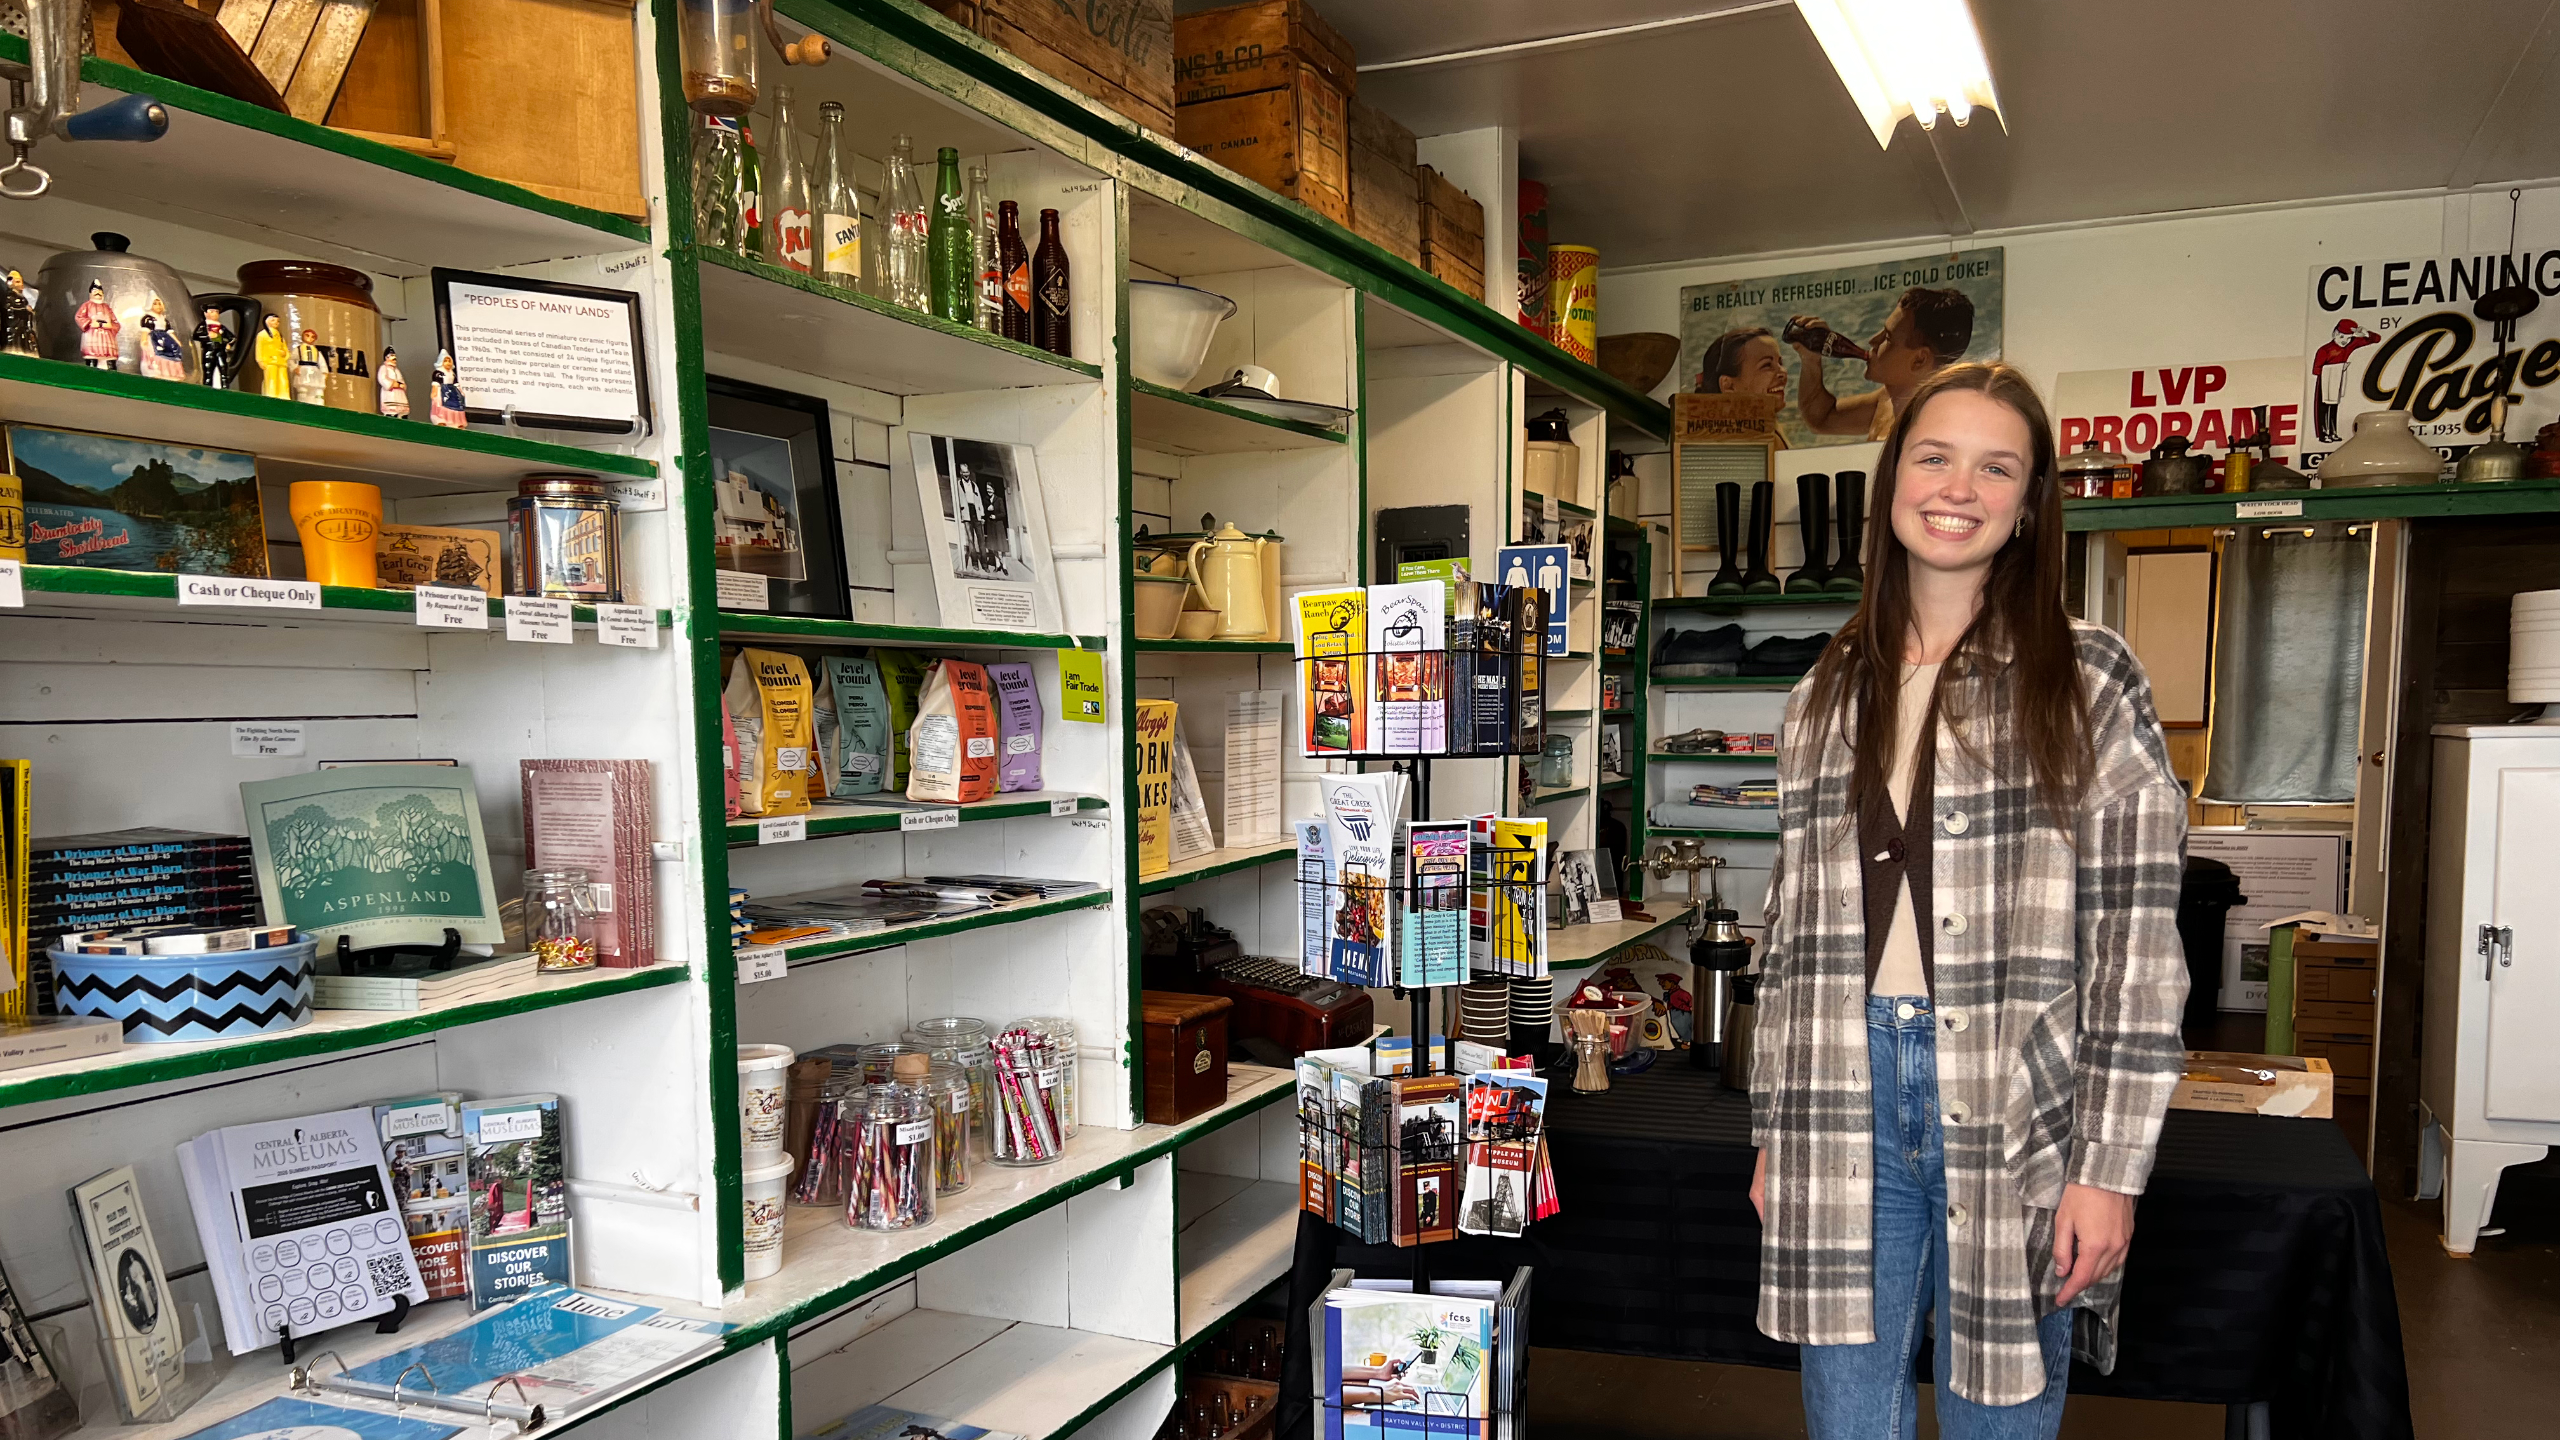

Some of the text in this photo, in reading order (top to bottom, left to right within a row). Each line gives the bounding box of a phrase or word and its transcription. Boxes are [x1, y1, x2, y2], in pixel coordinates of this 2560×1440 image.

[1220, 136, 1259, 151] CANADA
[604, 255, 648, 275] Unit Shelf 2
[1692, 296, 1711, 312] BE
[1716, 288, 1767, 310] REALLY
[1903, 267, 1940, 288] COLD
[1946, 260, 1990, 281] COKE!
[2316, 250, 2560, 312] CLEANING
[521, 300, 537, 311] OF
[539, 302, 573, 315] MANY
[455, 324, 470, 332] This
[471, 326, 514, 335] promotional
[2380, 316, 2402, 331] BY
[611, 348, 622, 356] Tea
[2130, 365, 2227, 409] LVP
[2061, 404, 2300, 456] PROPANE
[2433, 424, 2461, 435] 1935
[634, 489, 651, 498] Shelf
[26, 506, 75, 517] CELEBRATED
[58, 528, 130, 558] Shortbread
[382, 557, 430, 574] Earl Grey
[398, 569, 414, 583] Tea
[188, 582, 317, 604] Cash or Cheque Only
[425, 591, 450, 600] Prisoner
[1302, 598, 1338, 609] Bearpaw
[1380, 594, 1429, 616] BearSpaw
[444, 613, 463, 624] Free
[1303, 609, 1330, 619] Ranch
[531, 630, 549, 640] Free
[620, 635, 637, 645] Free
[760, 662, 788, 675] level
[840, 662, 864, 674] level
[836, 673, 872, 686] ground
[959, 669, 978, 681] level
[1000, 670, 1020, 682] level
[1068, 673, 1081, 681] am
[957, 678, 983, 692] ground
[1065, 680, 1100, 693] Fair Trade
[259, 745, 278, 754] Free
[1329, 797, 1350, 806] GREAT
[904, 816, 918, 825] Cash
[925, 814, 944, 824] Cheque
[944, 813, 958, 823] Only
[772, 830, 790, 839] $15.00
[1414, 832, 1440, 841] SUGAR
[53, 843, 183, 860] A Prisoner of War Diary
[1343, 850, 1387, 869] Deliciously
[53, 864, 182, 882] A Prisoner of War Diary
[55, 884, 184, 903] A Prisoner of War Diary
[323, 890, 451, 914] ASPENLAND
[57, 905, 186, 925] A Prisoner of War Diary
[753, 970, 772, 979] $15.00
[393, 1116, 445, 1130] MUSEUMS
[481, 1121, 542, 1136] MUSEUMS
[254, 1129, 349, 1150] CENTRAL ALBERTA
[908, 1131, 925, 1141] $1.00
[252, 1136, 358, 1170] MUSEUMS
[1485, 1149, 1527, 1159] TPPLE PAR
[1491, 1158, 1519, 1167] MUSEUM
[487, 1245, 548, 1265] DISCOVER
[440, 1267, 457, 1279] US
[505, 1260, 532, 1275] OUR
[494, 1272, 544, 1290] STORIES
[556, 1295, 627, 1319] June
[1448, 1311, 1471, 1324] fcss
[1440, 1421, 1466, 1431] DISTRIC
